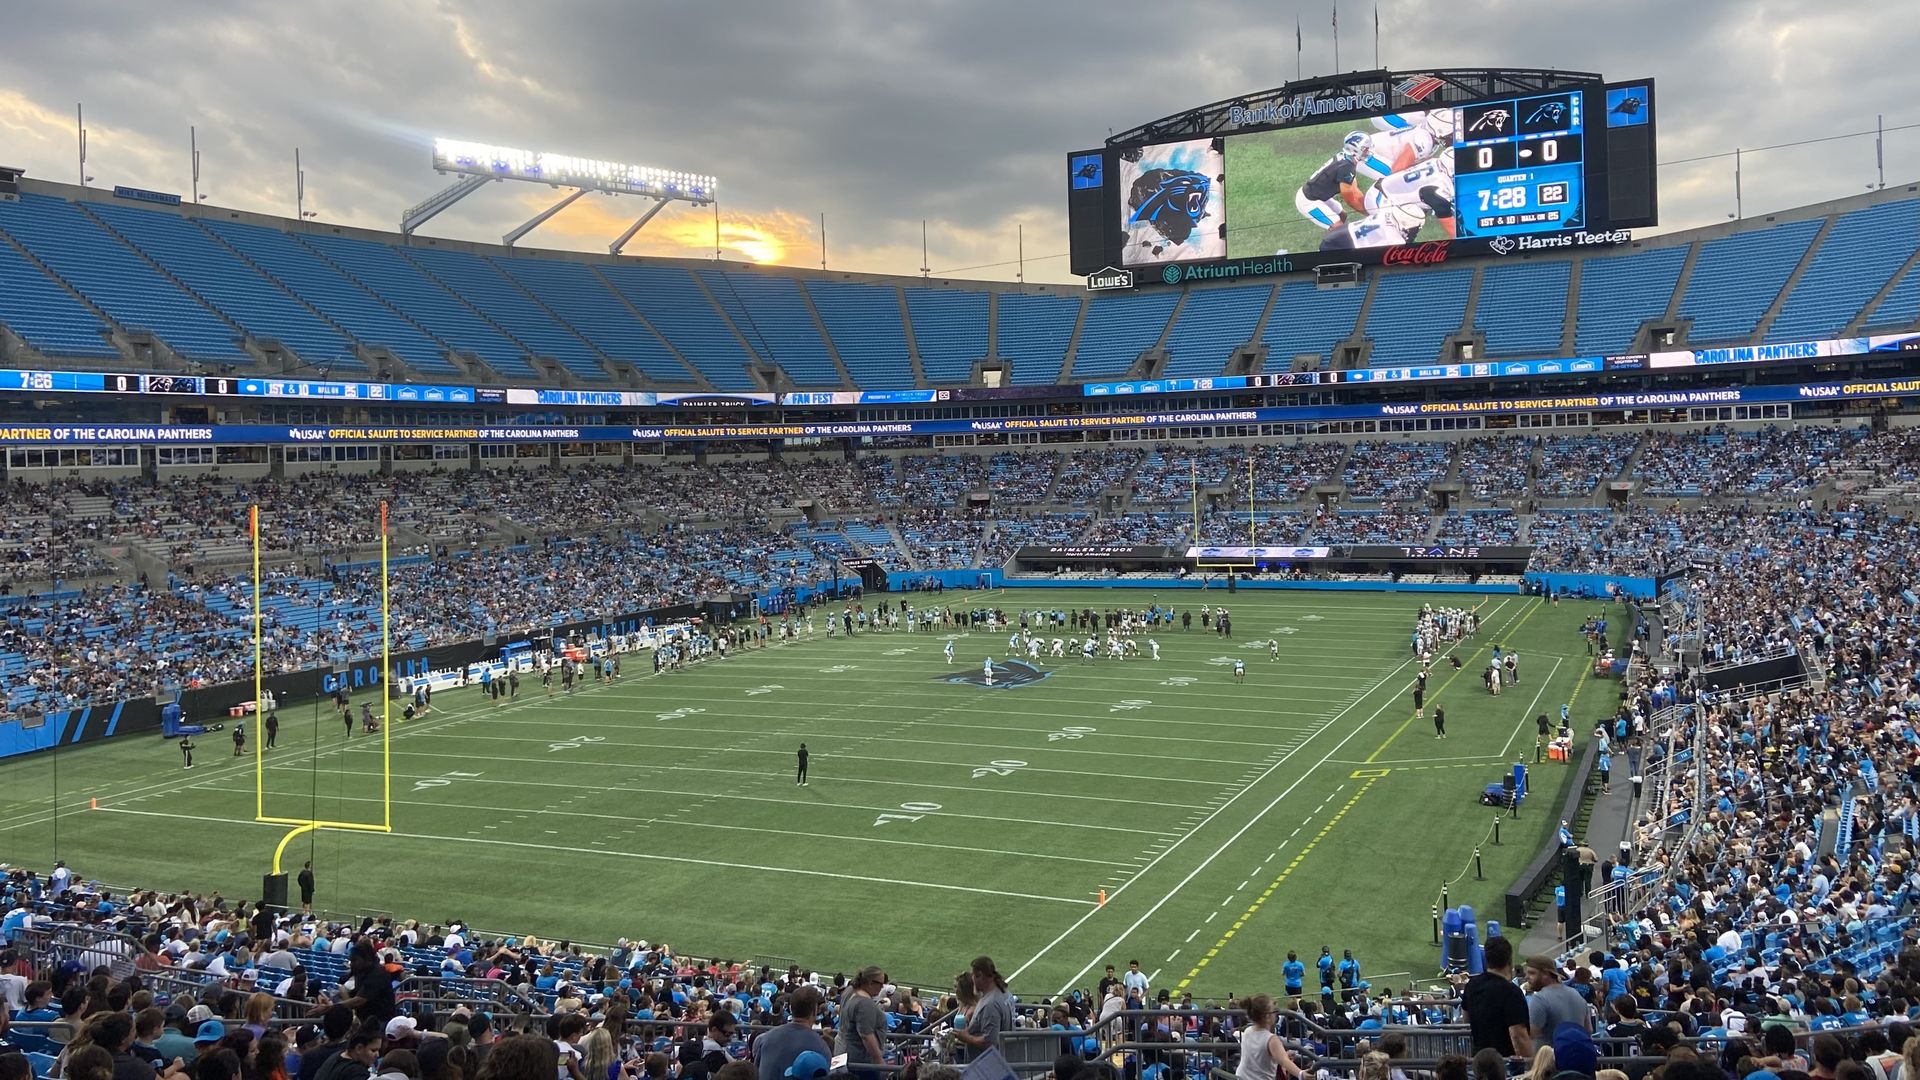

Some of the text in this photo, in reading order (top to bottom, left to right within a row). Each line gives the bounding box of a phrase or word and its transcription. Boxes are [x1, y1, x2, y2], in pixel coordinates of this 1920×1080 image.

[1230, 90, 1386, 125] Bank of America
[1478, 148, 1492, 169] 0
[1543, 140, 1558, 162] 0
[1478, 186, 1526, 211] 7:28
[1542, 185, 1562, 202] 22
[1480, 216, 1494, 227] 1ST
[1498, 216, 1504, 226] &
[1506, 214, 1516, 224] 10
[1548, 212, 1559, 221] 25
[1518, 230, 1632, 250] Harris Teeter
[1186, 258, 1294, 280] Atrium Health
[1091, 274, 1128, 288] LOWE'S
[1694, 342, 1818, 364] CAROLINA PANTHERS
[1374, 371, 1388, 380] 1ST
[117, 376, 127, 391] 0
[218, 380, 227, 394] 0
[1843, 384, 1889, 394] OFFICIAL
[538, 390, 622, 405] CAROLINA PANTHERS
[1421, 404, 1461, 412] OFFICIAL
[1463, 402, 1498, 411] SALUTE
[1514, 400, 1553, 409] SERVICE
[1555, 398, 1598, 407] PARTNER
[1601, 397, 1613, 405] OF
[1616, 395, 1634, 405] THE
[1637, 394, 1688, 403] CAROLINA
[1690, 391, 1740, 401] PANTHERS
[1112, 416, 1146, 425] PARTNER
[1175, 414, 1215, 422] CAROLINA
[1216, 412, 1257, 420] PANTHERS
[54, 429, 70, 439] OF
[73, 429, 95, 439] THE
[98, 429, 156, 440] CAROLINA
[158, 429, 212, 440] PANTHERS
[329, 429, 367, 439] OFFICIAL
[368, 429, 398, 439] SALUTE
[400, 429, 410, 438] TO
[412, 429, 443, 438] SERVICE
[445, 430, 478, 438] PARTNER
[479, 430, 490, 438] OF
[490, 430, 504, 438] THE
[505, 430, 543, 438] CAROLINA
[543, 430, 579, 438] PANTHERS
[738, 427, 768, 435] SERVICE
[769, 427, 804, 435] PARTNER
[873, 424, 912, 432] PANTHERS
